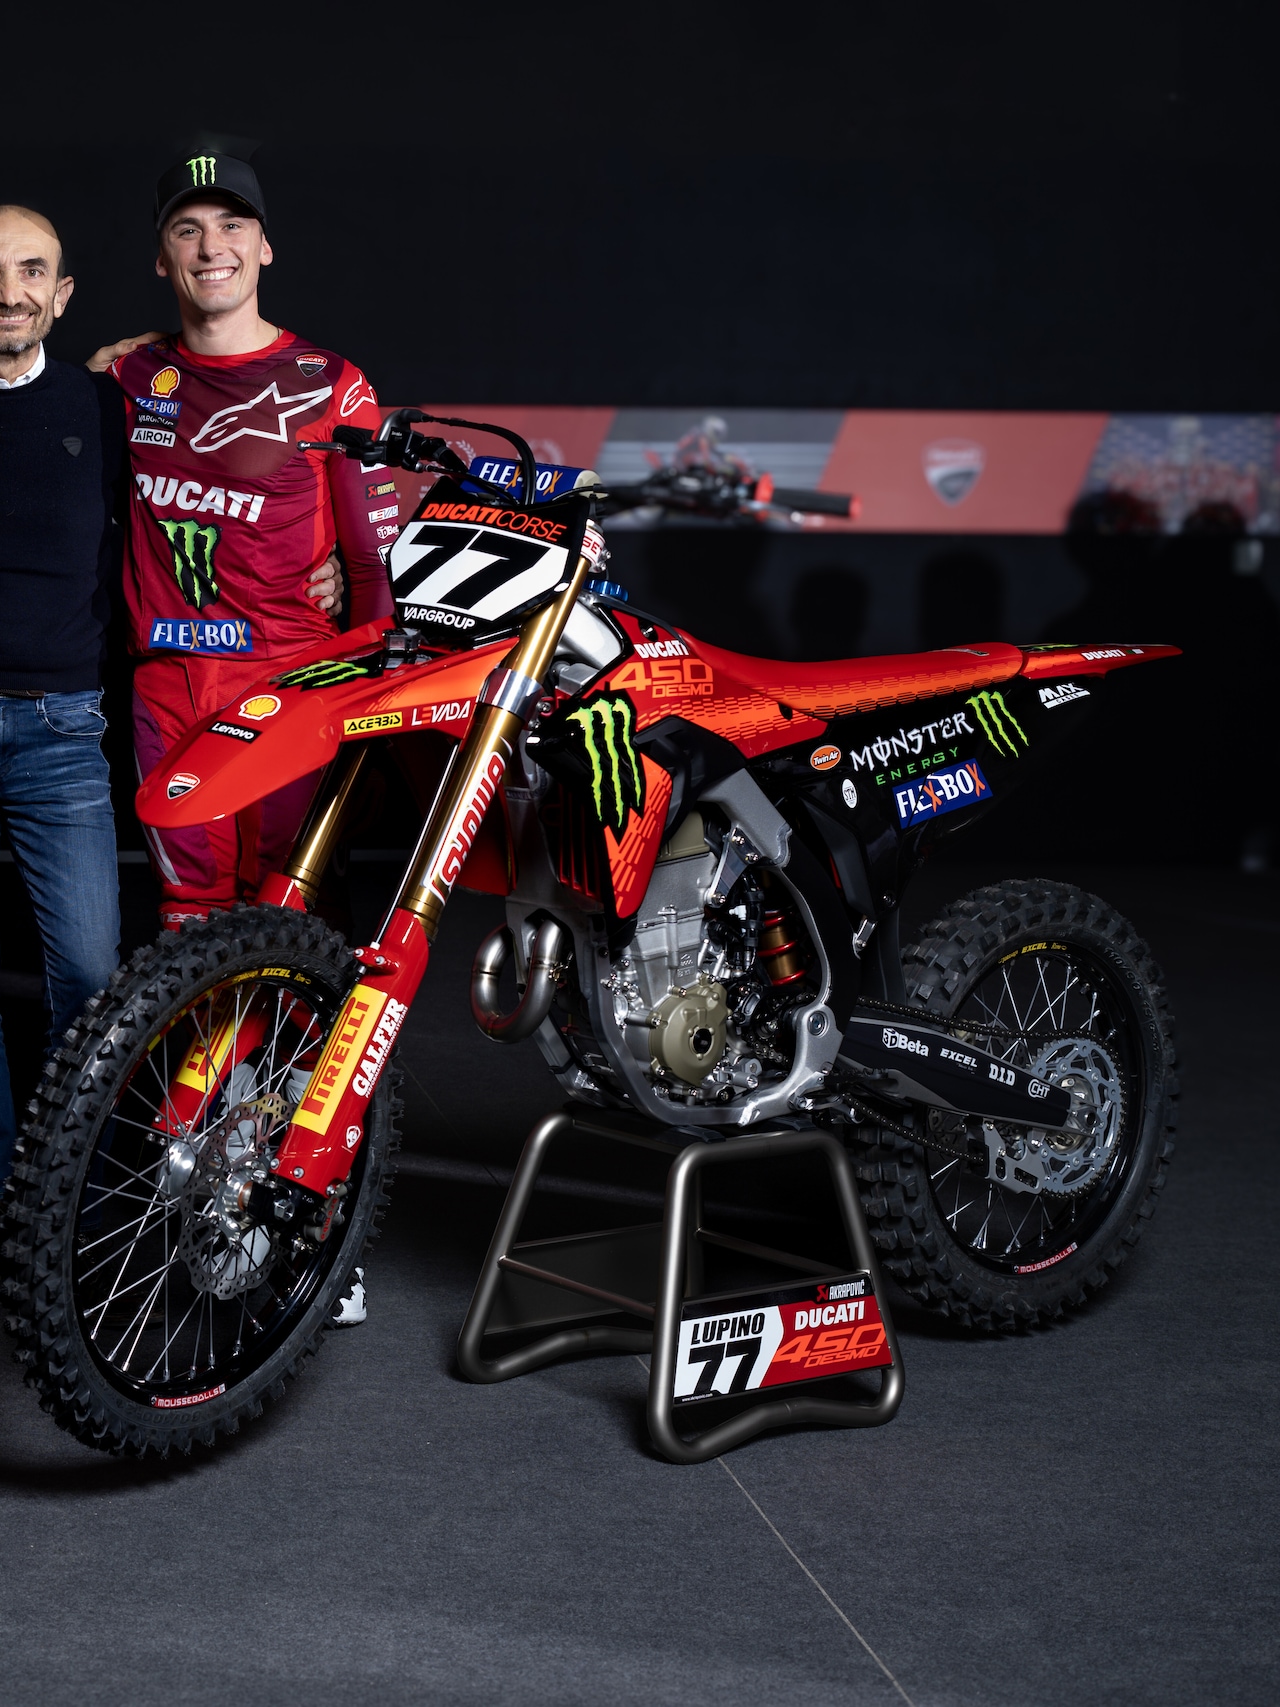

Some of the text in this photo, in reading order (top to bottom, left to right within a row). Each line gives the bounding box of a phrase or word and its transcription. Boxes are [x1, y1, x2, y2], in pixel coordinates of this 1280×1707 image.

[134, 429, 174, 445] AIROH
[135, 472, 266, 524] DUCATI
[393, 524, 552, 611] 77
[403, 606, 476, 630] VARGROUP
[152, 617, 252, 651] FLEX-BOX
[633, 639, 690, 659] DUCATI
[1081, 649, 1126, 661] DUCATI
[609, 658, 714, 692] 450
[651, 683, 714, 699] DESMO
[1038, 682, 1084, 703] MAX
[411, 701, 471, 727] LEVADA
[211, 722, 255, 740] Lenovo
[813, 752, 828, 766] Twin
[875, 746, 959, 786] ENERGY
[174, 774, 198, 786] DUCATI
[895, 762, 986, 819] FLEX-BOX
[440, 752, 506, 890] SHOWA
[1021, 941, 1048, 954] EXCEL
[260, 967, 291, 979] EXCEL
[299, 996, 371, 1117] PIRELLI
[351, 997, 406, 1097] GALFER
[897, 1034, 929, 1057] Beta
[939, 1047, 978, 1068] EXCEL
[794, 1300, 866, 1331] DUCATI
[690, 1312, 766, 1346] LUPINO
[771, 1322, 887, 1364] 450
[687, 1336, 763, 1395] 77
[803, 1344, 881, 1369] DESMO
[157, 1388, 220, 1408] MOUSSEBALLS
